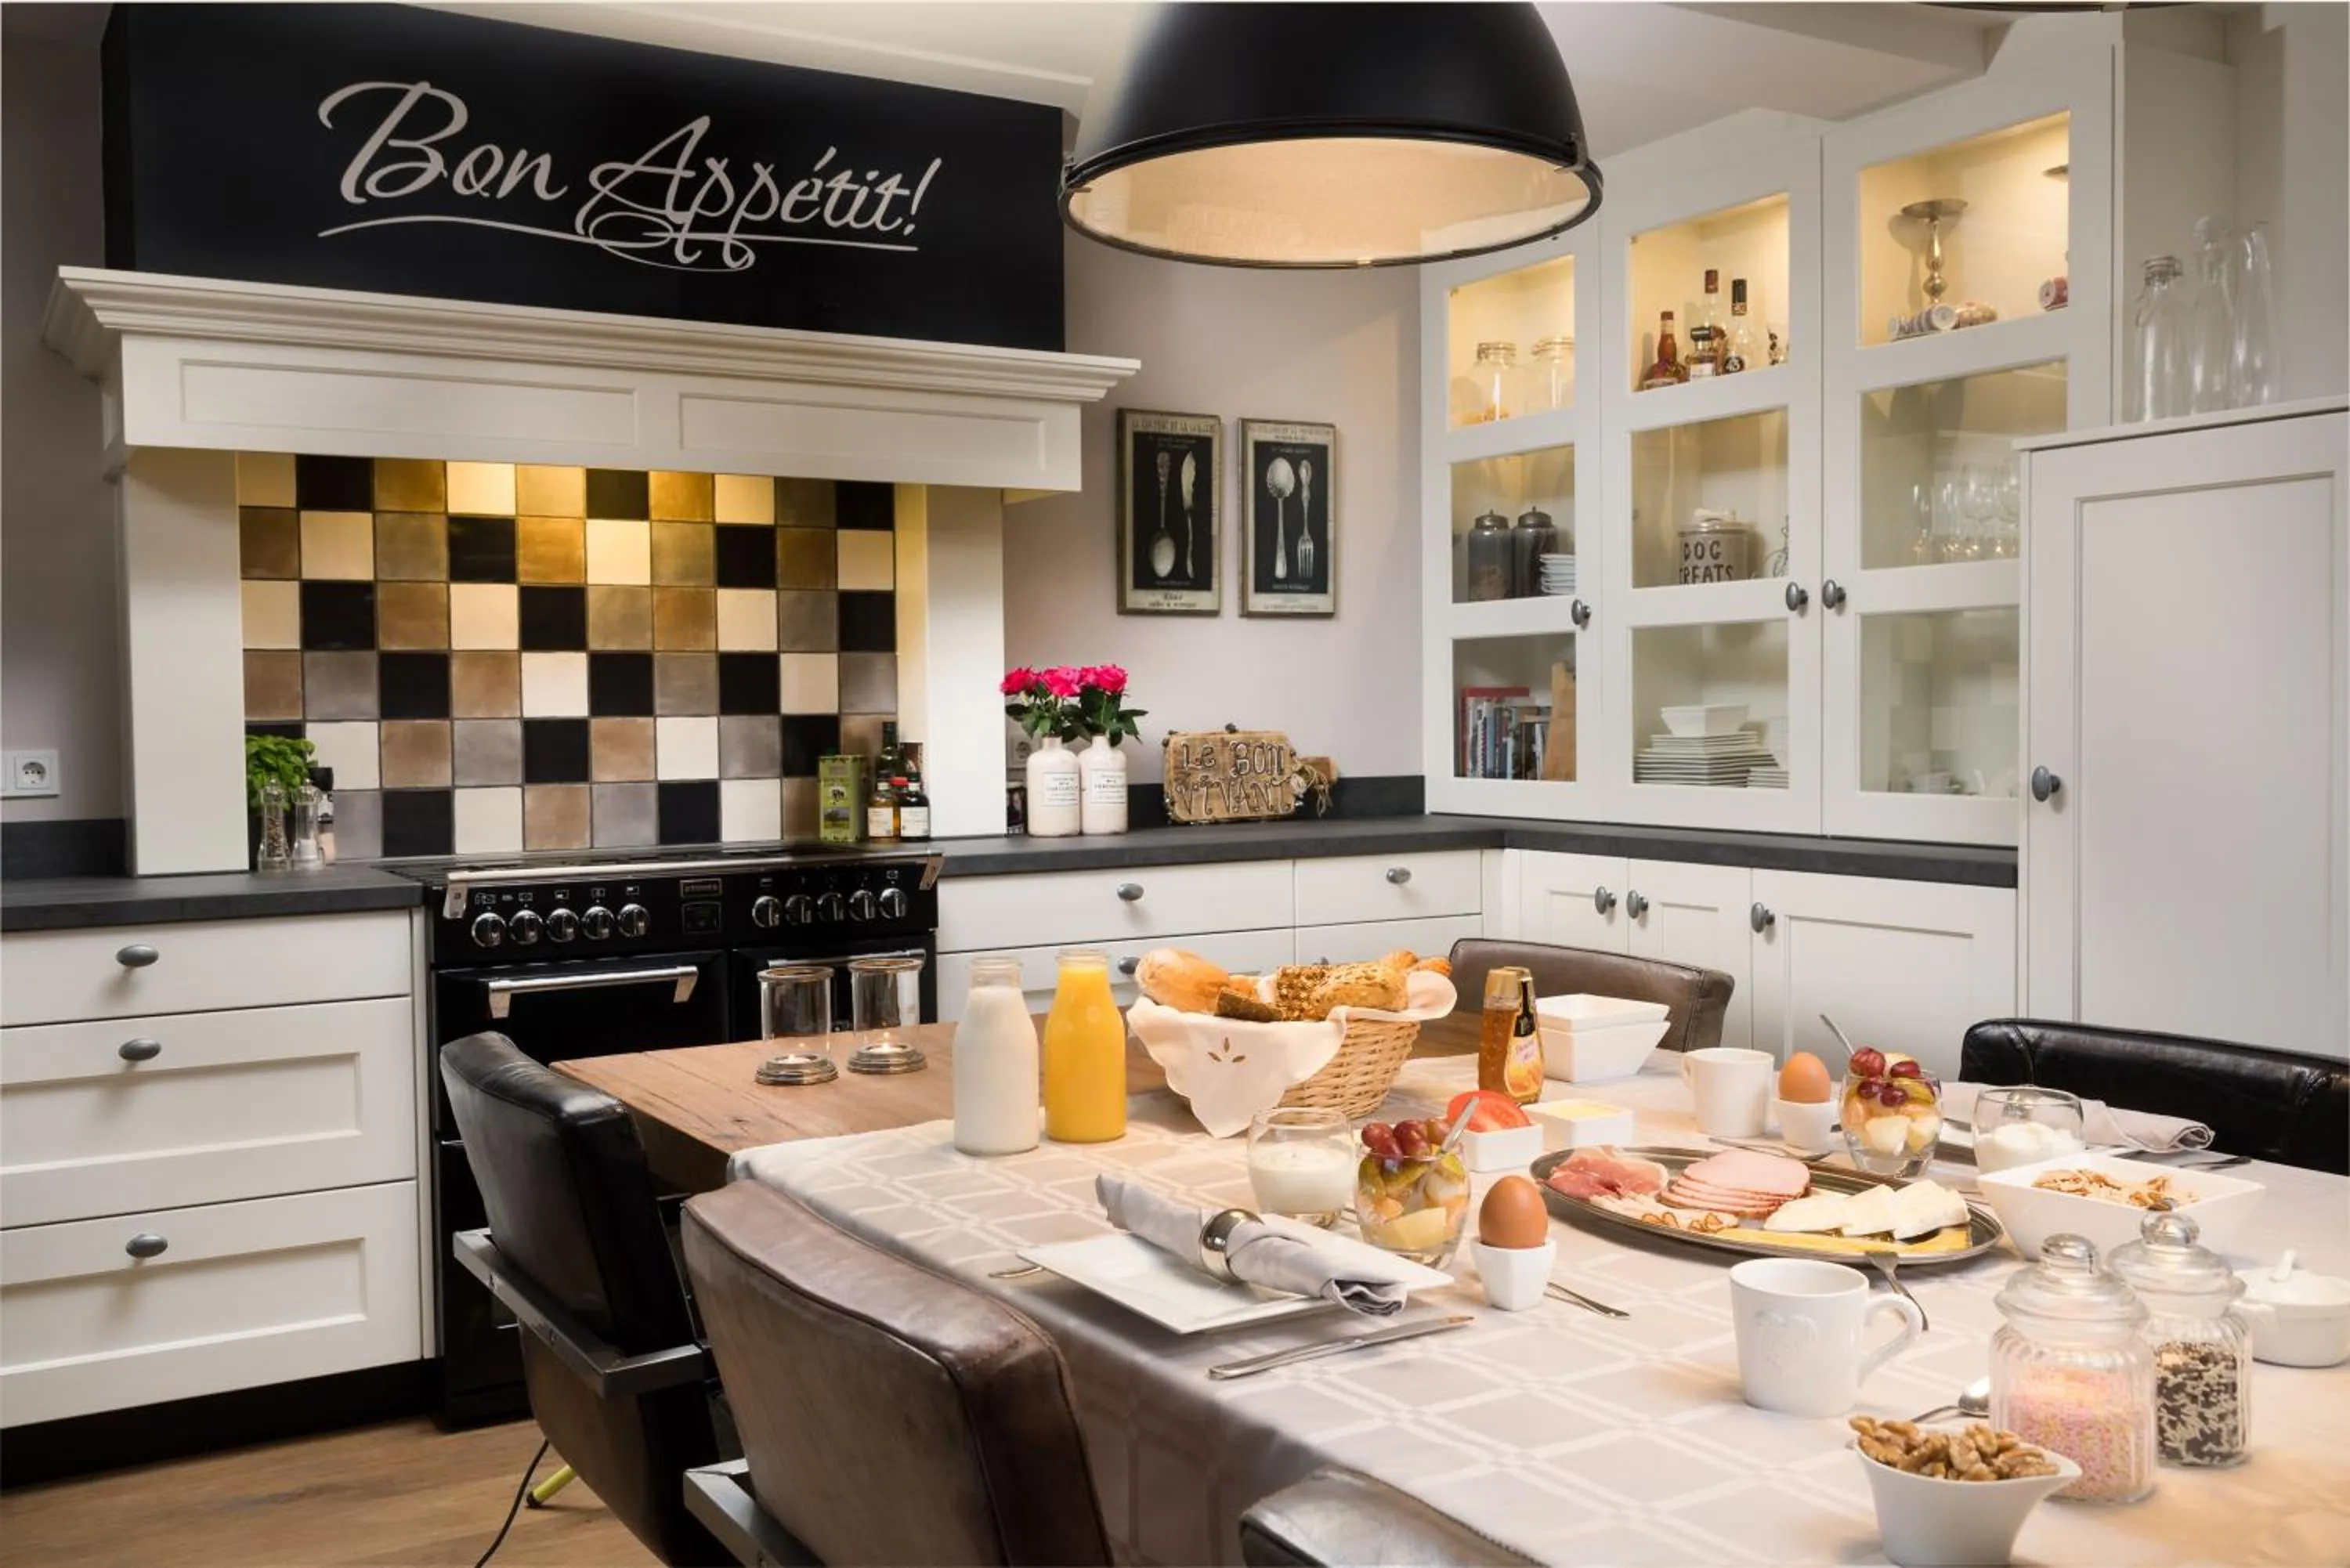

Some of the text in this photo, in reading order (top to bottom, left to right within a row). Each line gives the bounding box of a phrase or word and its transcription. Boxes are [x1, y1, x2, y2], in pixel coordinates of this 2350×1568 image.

[317, 81, 942, 267] Bon Appétit!
[1683, 540, 1723, 562] DOG
